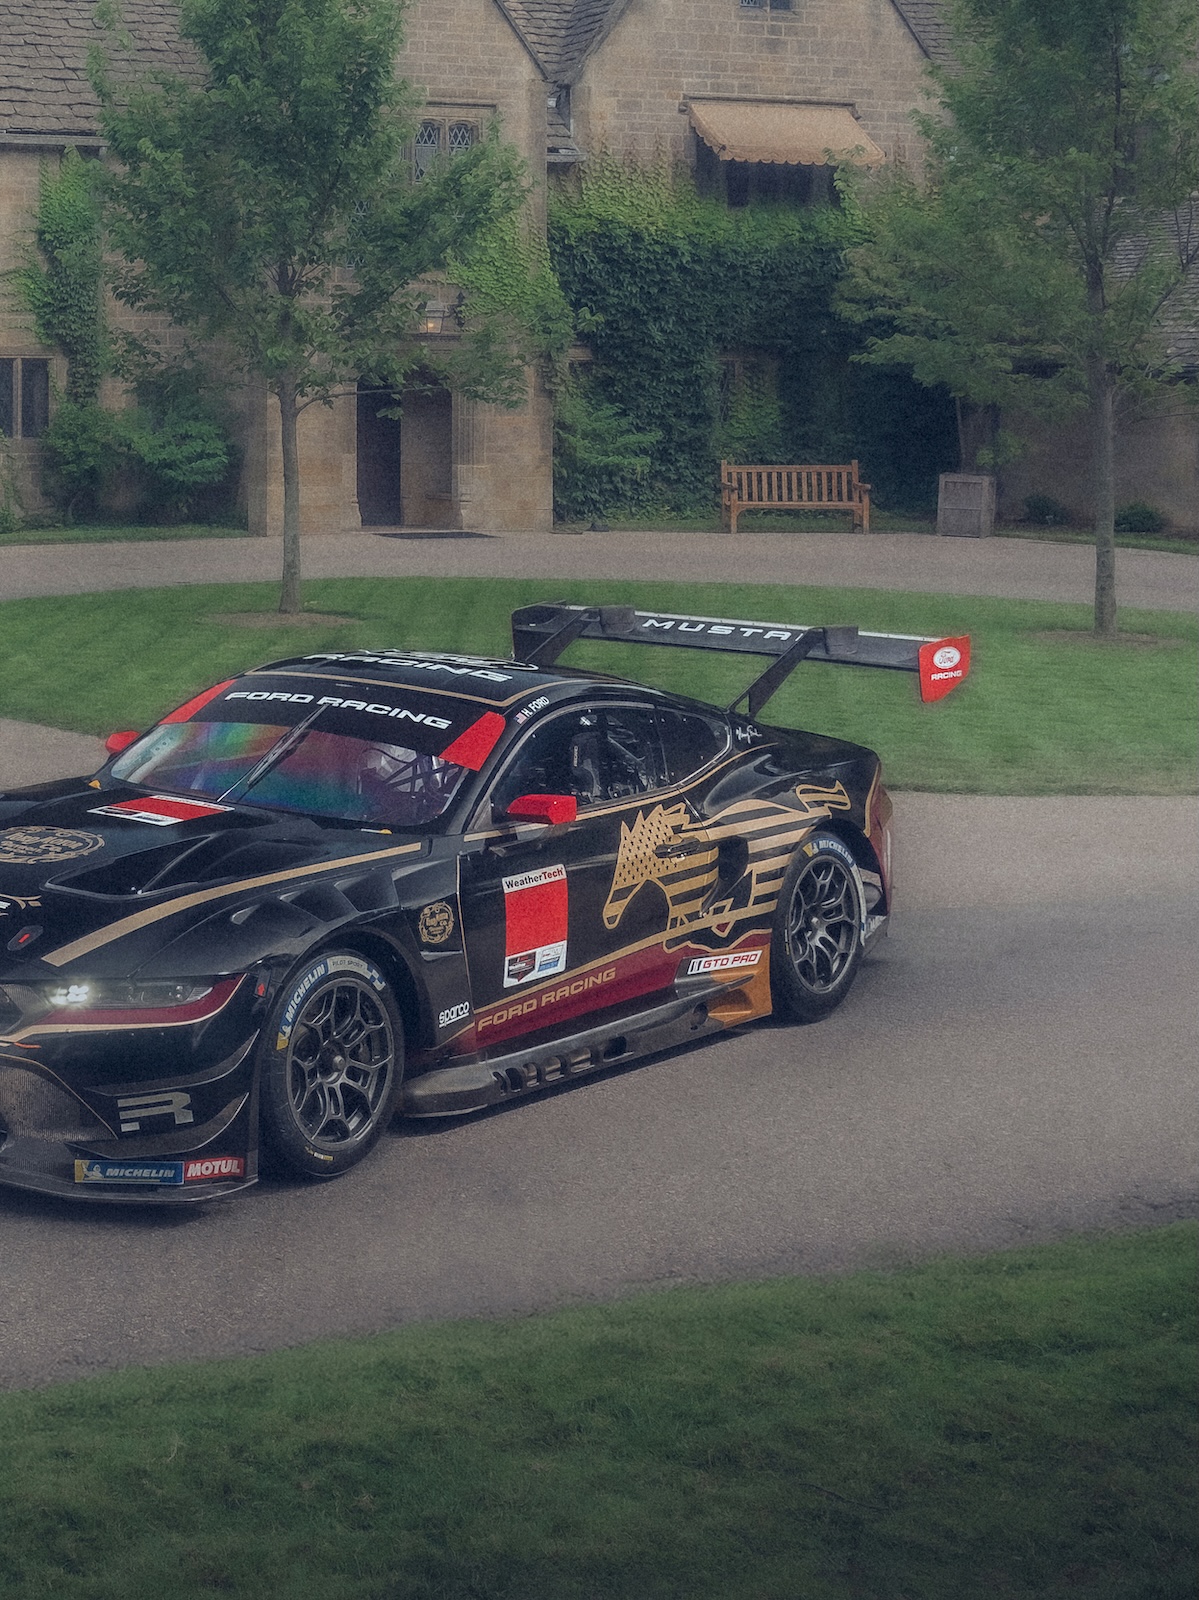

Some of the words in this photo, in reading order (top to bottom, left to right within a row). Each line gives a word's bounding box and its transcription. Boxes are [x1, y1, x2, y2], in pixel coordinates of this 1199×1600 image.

[930, 669, 963, 681] RACING
[225, 691, 315, 701] FORD
[317, 696, 452, 730] RACING
[528, 695, 550, 712] FORD
[505, 867, 564, 889] WeatherTech
[703, 957, 730, 969] GTD
[731, 953, 758, 964] PRO
[285, 963, 326, 1023] MICHELIN
[477, 998, 538, 1032] FORD
[541, 967, 617, 1007] RACING
[439, 1001, 470, 1027] sparco
[105, 1167, 176, 1178] MICHELIN
[186, 1159, 241, 1178] MOTUL
